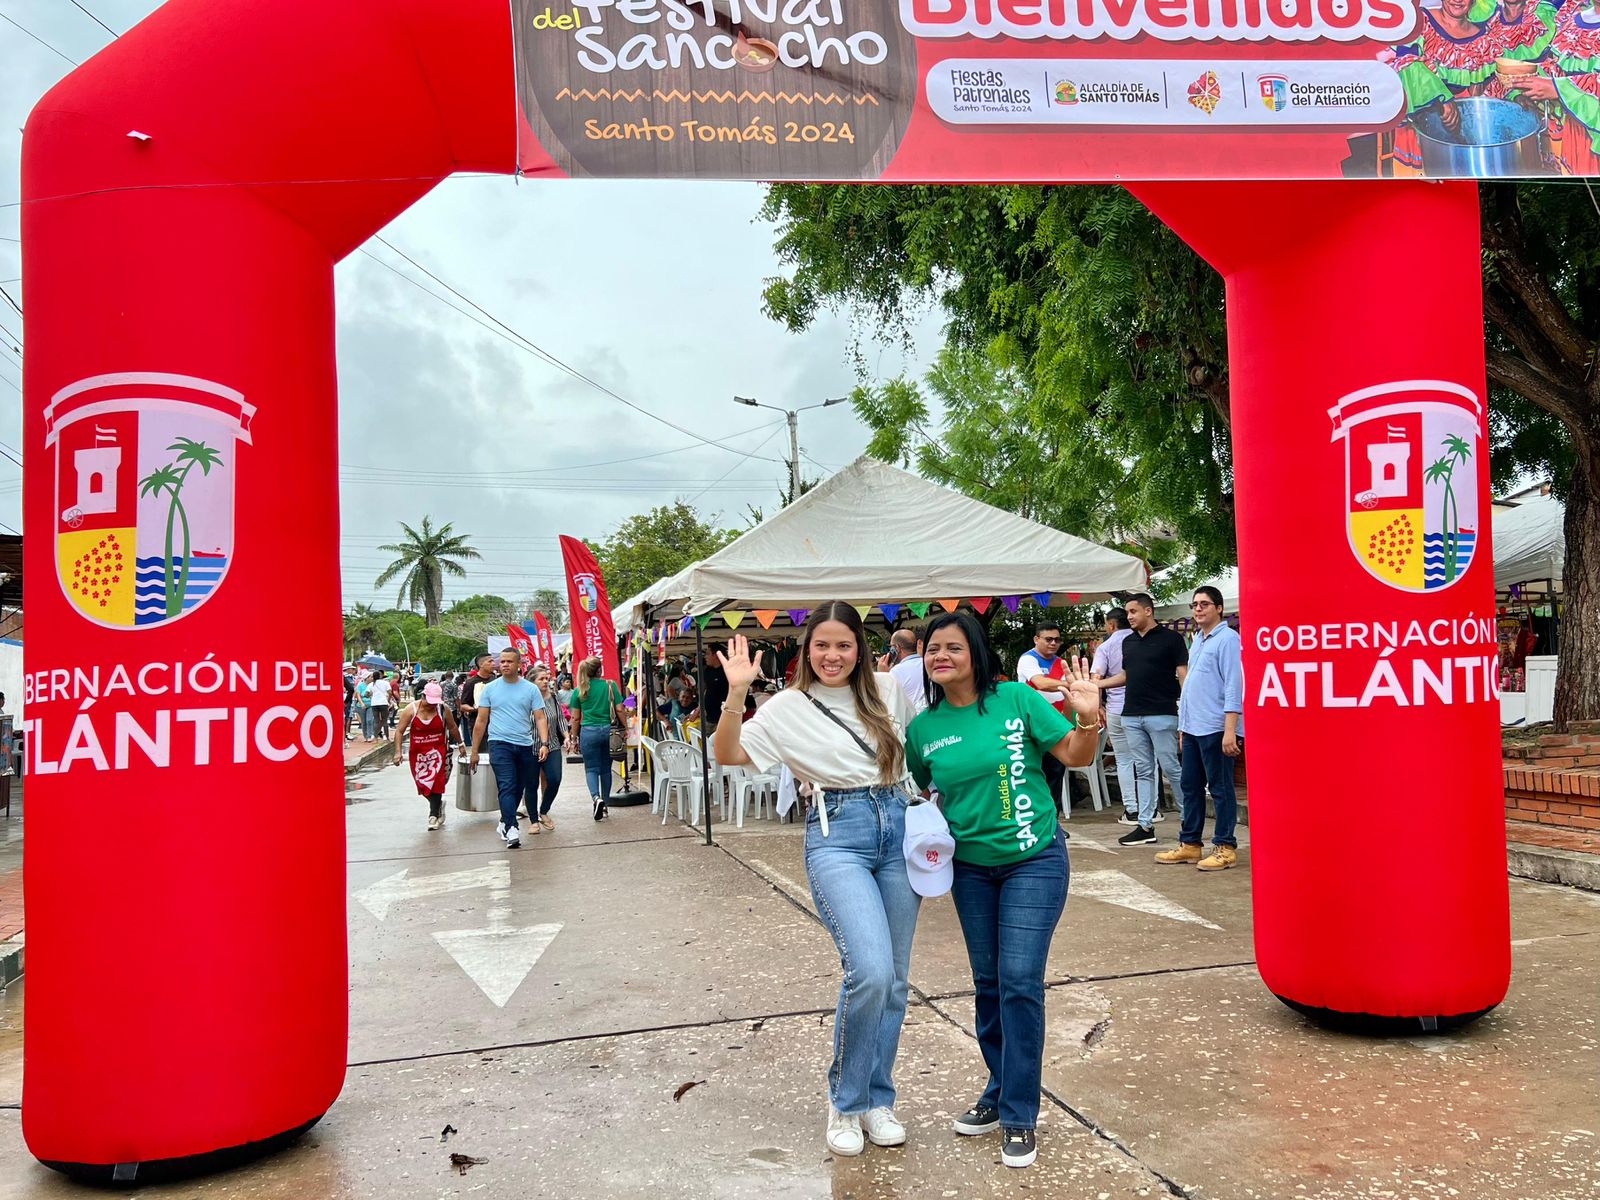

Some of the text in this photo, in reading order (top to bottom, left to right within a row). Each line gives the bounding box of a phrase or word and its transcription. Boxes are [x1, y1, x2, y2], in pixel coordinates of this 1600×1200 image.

[532, 7, 581, 30] del
[950, 69, 1004, 87] Fiestas
[1080, 81, 1129, 93] ALCALDÍA
[1130, 83, 1144, 93] DE
[953, 87, 1031, 104] Patronales
[1080, 88, 1160, 103] SANTO TOMÁS
[1290, 82, 1370, 94] Gobernación
[953, 104, 1032, 113] Santo Tomás 2024
[1292, 94, 1371, 106] del Atlántico
[585, 116, 855, 145] Santo Tomás 2024
[1256, 611, 1491, 652] GOBERNACIÓN
[24, 652, 331, 705] BERNACIÓN DEL
[1000, 717, 1027, 791] TOMÁS
[997, 763, 1011, 820] Alcaldía de
